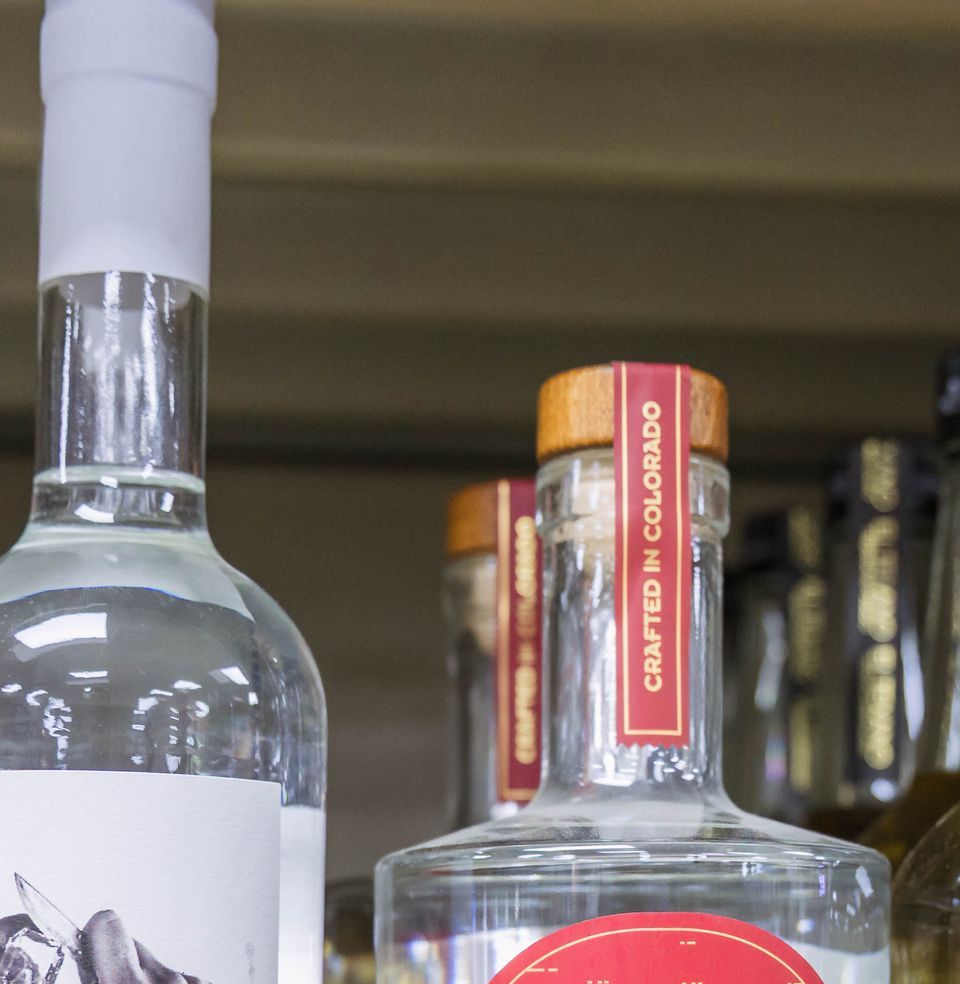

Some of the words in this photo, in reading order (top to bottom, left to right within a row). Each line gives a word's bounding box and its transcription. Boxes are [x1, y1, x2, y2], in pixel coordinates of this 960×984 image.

[642, 400, 662, 543] COLORADO
[643, 550, 661, 573] IN
[643, 578, 662, 693] CRAFTED
